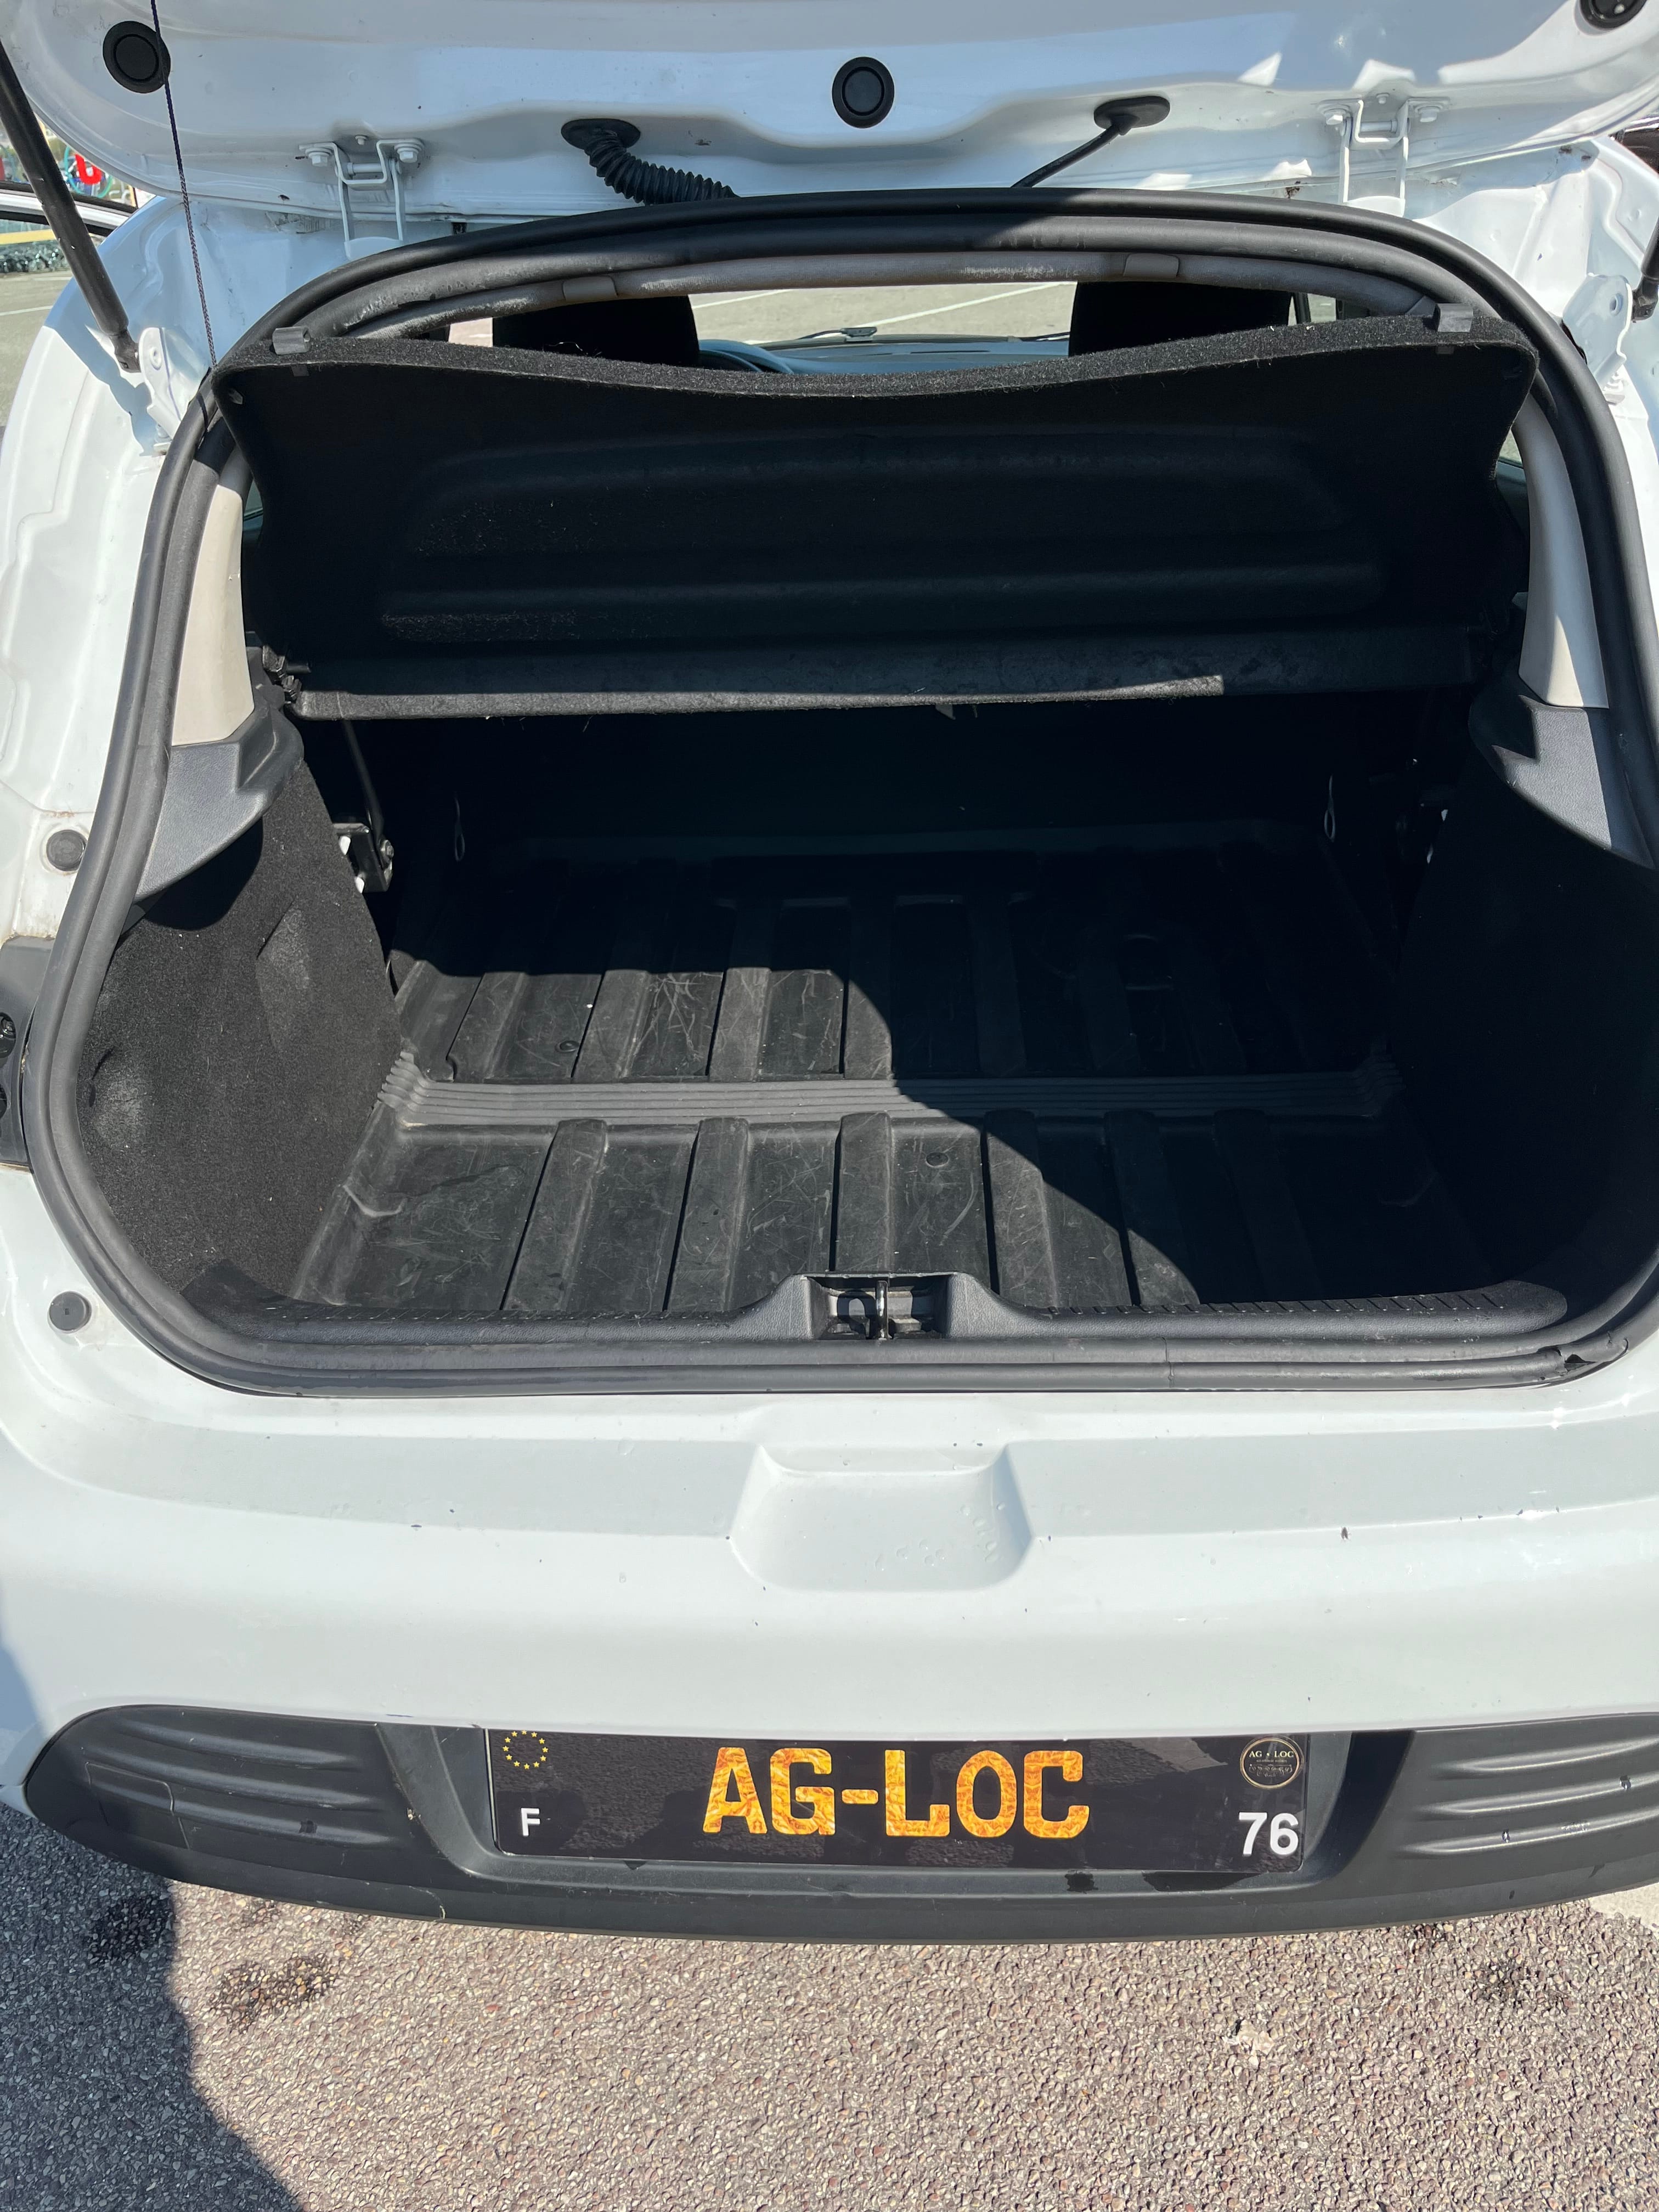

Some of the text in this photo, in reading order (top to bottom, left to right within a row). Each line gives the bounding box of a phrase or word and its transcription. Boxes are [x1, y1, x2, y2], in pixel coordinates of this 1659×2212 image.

[703, 1747, 1090, 1838] AG-LOC
[521, 1808, 540, 1836] F
[1238, 1812, 1299, 1856] 76
